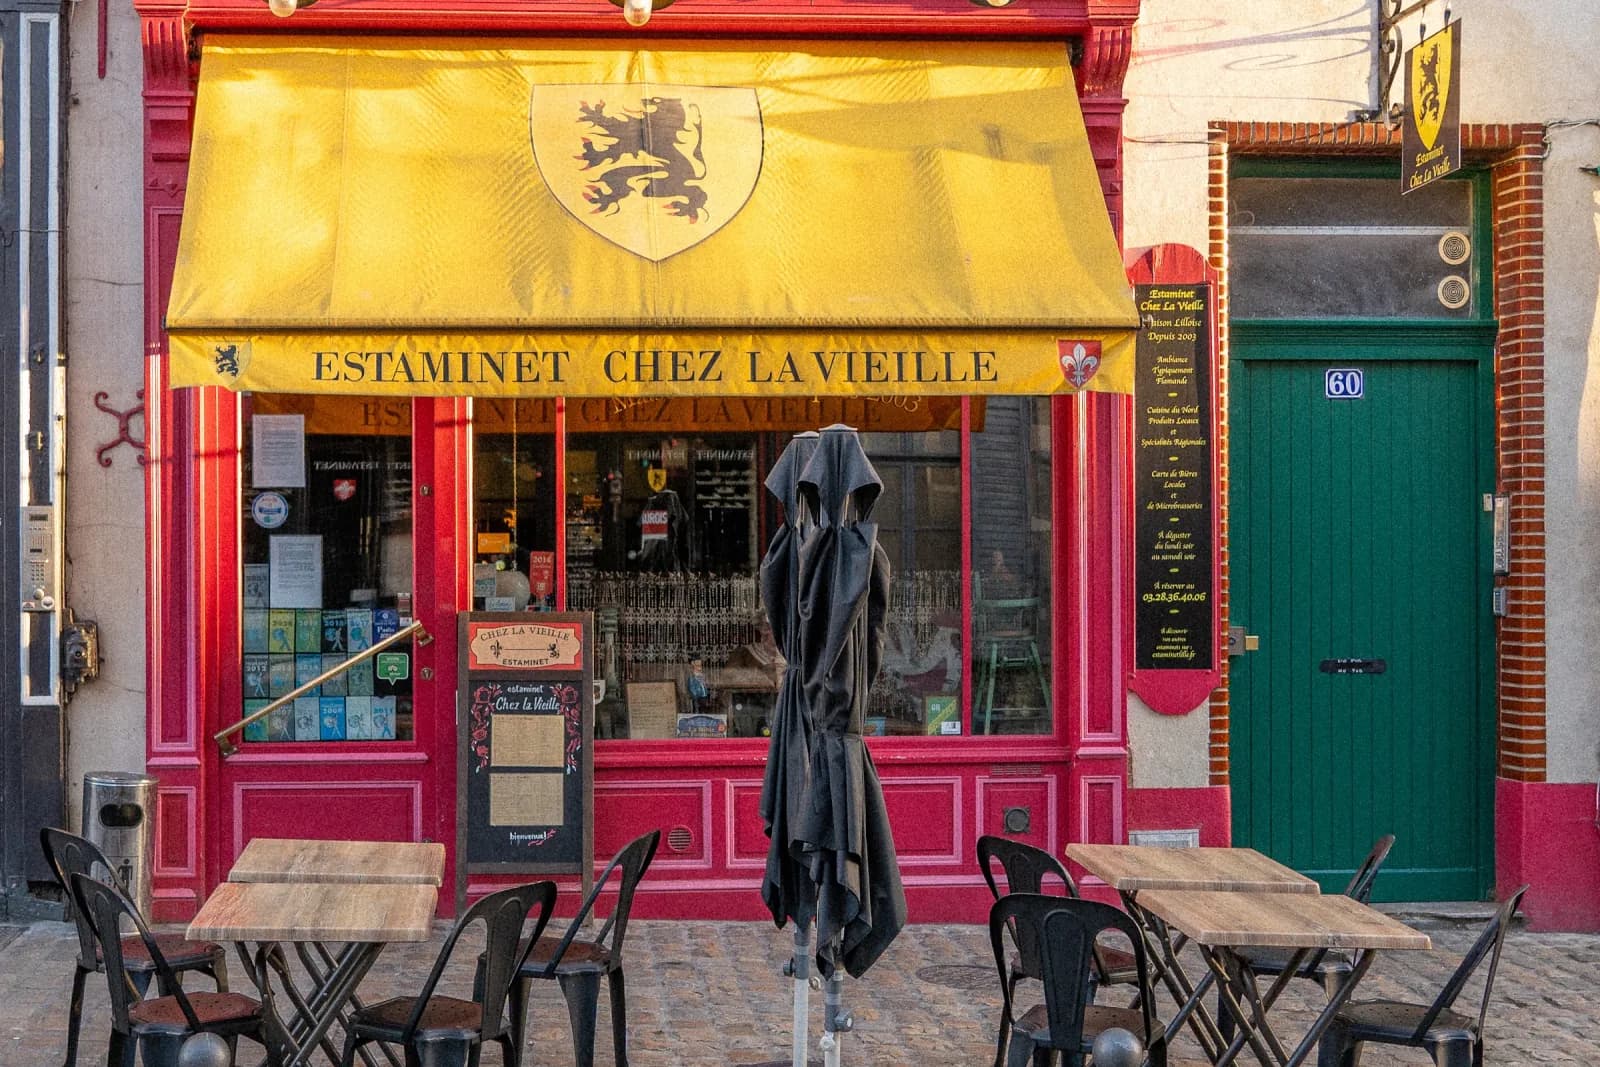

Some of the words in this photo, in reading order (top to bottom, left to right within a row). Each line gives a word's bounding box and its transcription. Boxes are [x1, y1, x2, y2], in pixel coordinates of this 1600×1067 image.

[1415, 144, 1444, 167] Estaminet
[1409, 170, 1423, 188] Chez
[1424, 168, 1432, 182] La
[1432, 155, 1450, 177] Vieille
[1149, 289, 1195, 299] Estaminet
[1141, 300, 1161, 311] Chez
[1163, 301, 1175, 311] La
[1177, 299, 1204, 311] Vieille
[1142, 317, 1172, 327] aison
[1174, 316, 1202, 327] Lilloise
[1147, 332, 1176, 344] Depuis
[1177, 333, 1197, 342] 2003
[1157, 354, 1189, 364] Ambiance
[311, 351, 570, 383] ESTAMINET
[603, 350, 723, 383] CHEZ
[746, 351, 805, 383] LA
[810, 351, 998, 383] VIEILLE
[1156, 376, 1188, 385] Flamande
[1329, 372, 1360, 395] 60
[1142, 591, 1207, 603] 03.28.36.40.06
[480, 628, 510, 641] CHEZ
[512, 627, 526, 635] LA
[529, 626, 570, 641] VIEILLE
[502, 658, 549, 666] ESTAMINET
[507, 684, 545, 694] estaminet
[495, 697, 520, 711] Chez
[522, 697, 533, 711] la
[533, 697, 560, 711] Vieille
